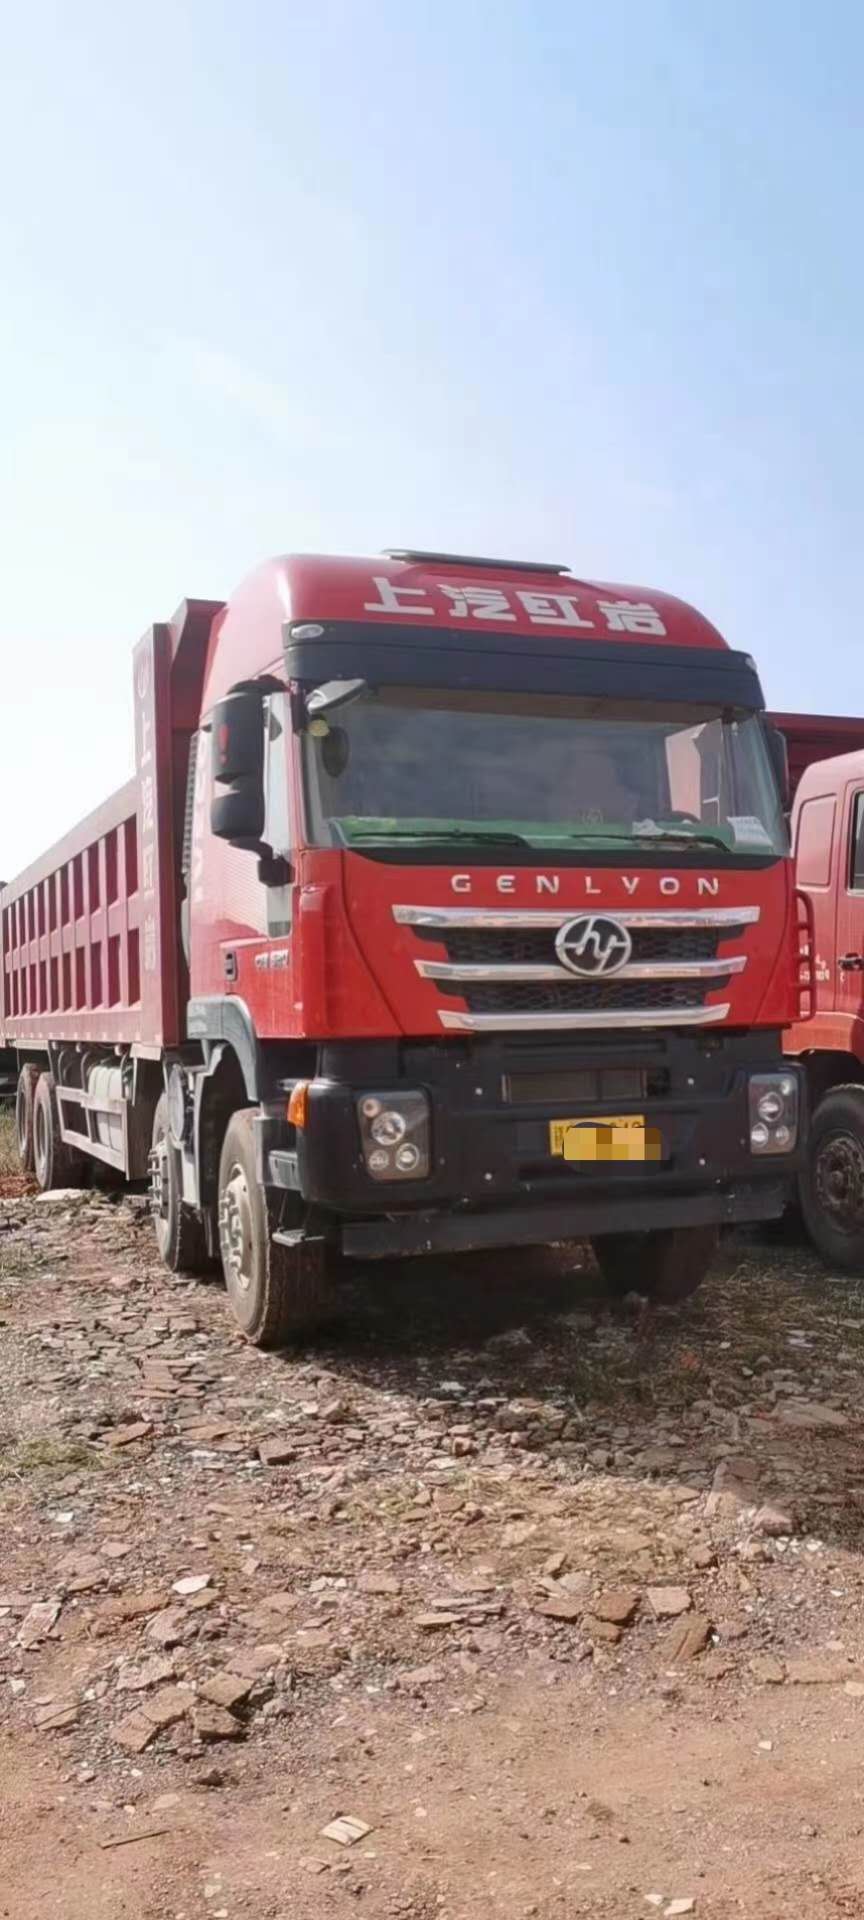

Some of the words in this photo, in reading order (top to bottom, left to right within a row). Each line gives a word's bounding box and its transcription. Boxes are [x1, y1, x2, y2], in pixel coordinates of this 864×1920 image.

[364, 576, 667, 636] 上汽红岩
[450, 873, 720, 896] GENLYON
